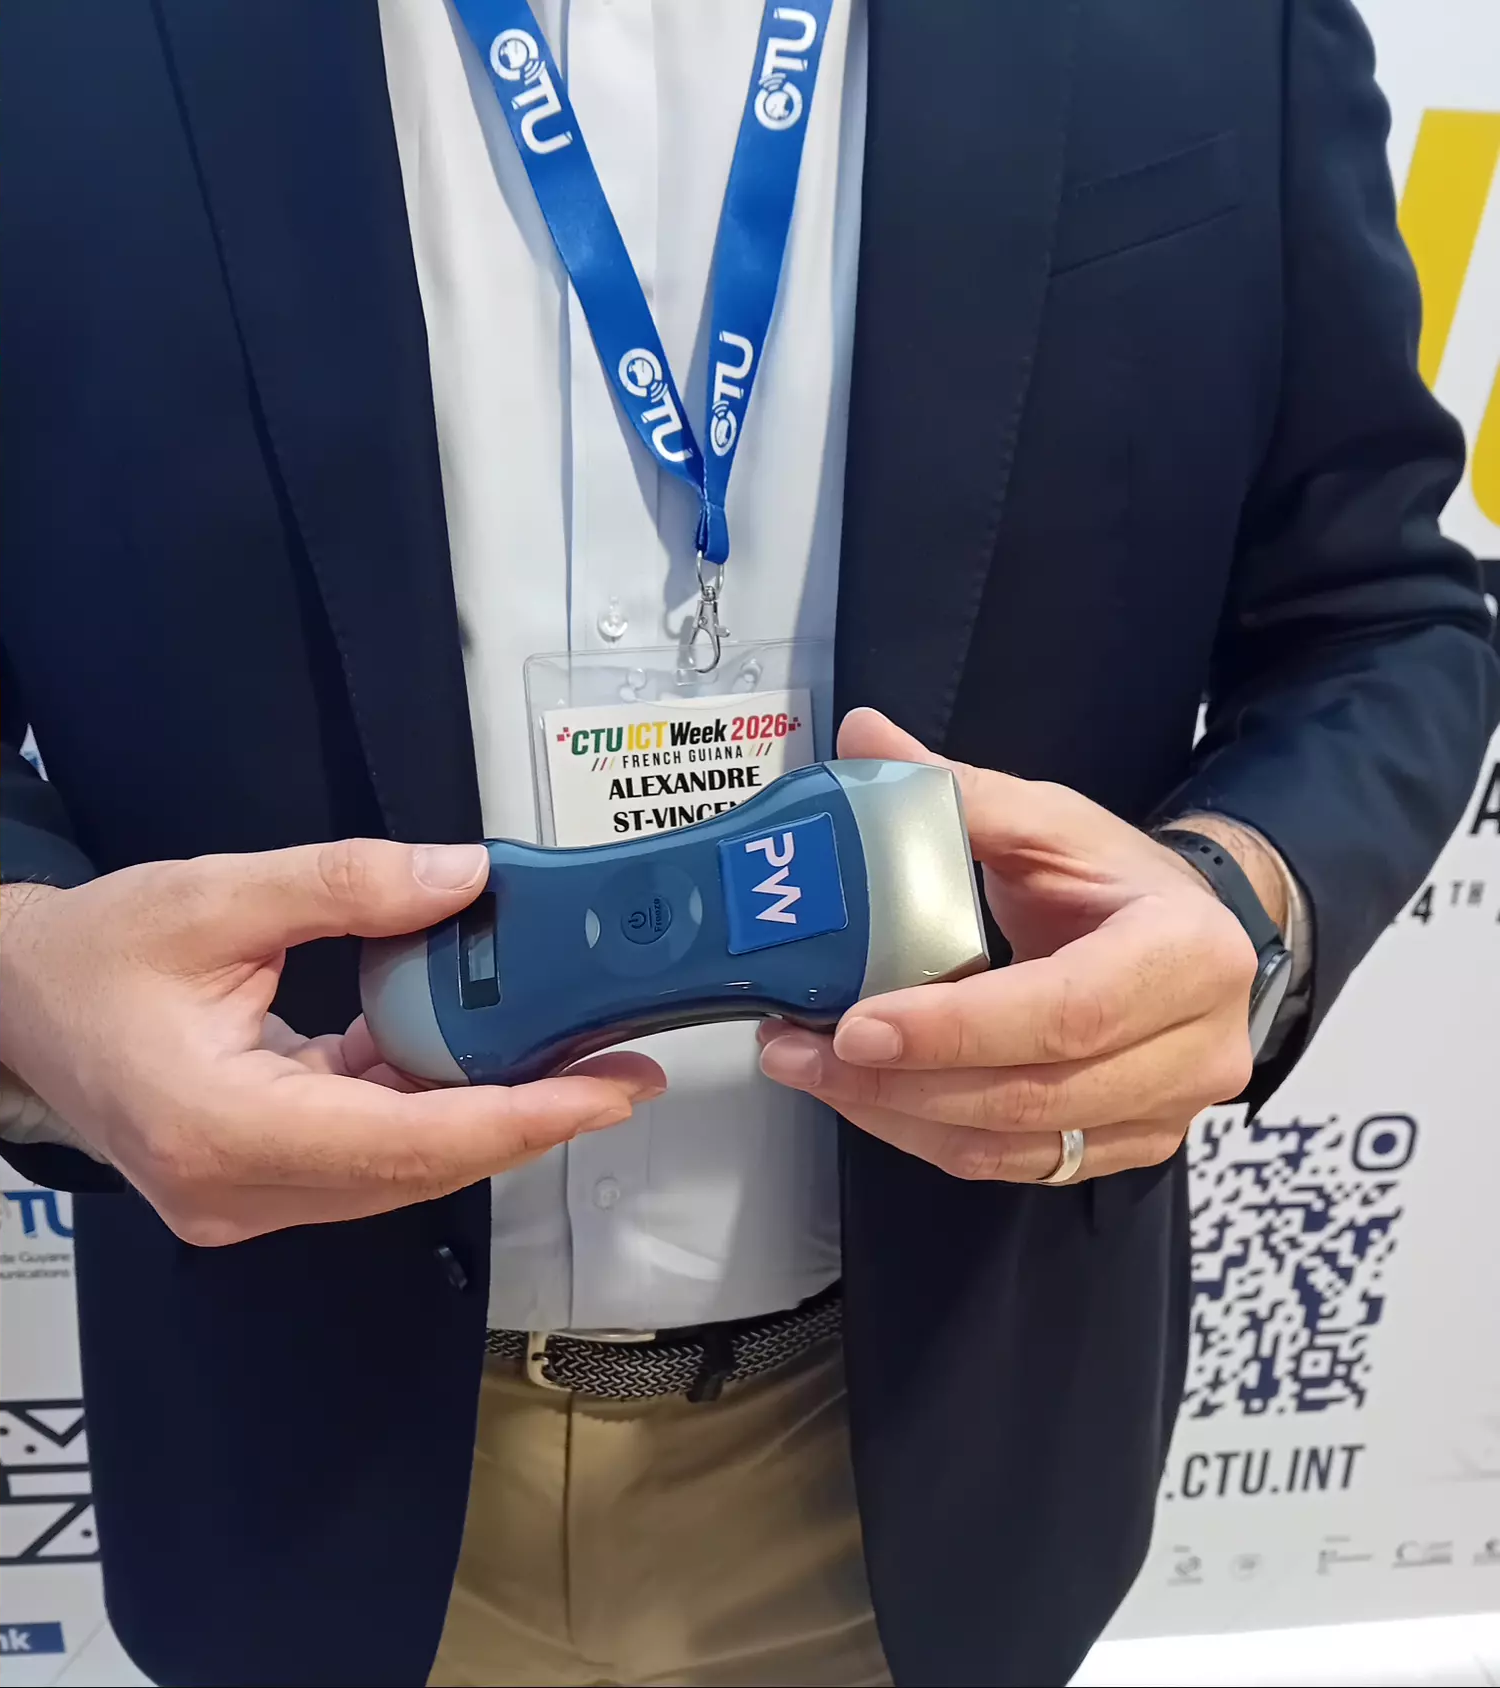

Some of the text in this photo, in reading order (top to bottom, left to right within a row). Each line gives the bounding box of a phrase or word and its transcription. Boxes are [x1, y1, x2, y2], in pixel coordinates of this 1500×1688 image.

[489, 28, 572, 154] CTU
[754, 7, 817, 130] CTU
[619, 348, 692, 462] CTU
[710, 331, 753, 456] CTU
[571, 713, 788, 755] CTU ICT Week 2026
[623, 746, 742, 769] FRENCH GUIANA
[609, 766, 762, 800] ALEXANDRE
[614, 801, 746, 833] ST-VINCE
[745, 832, 802, 925] PW
